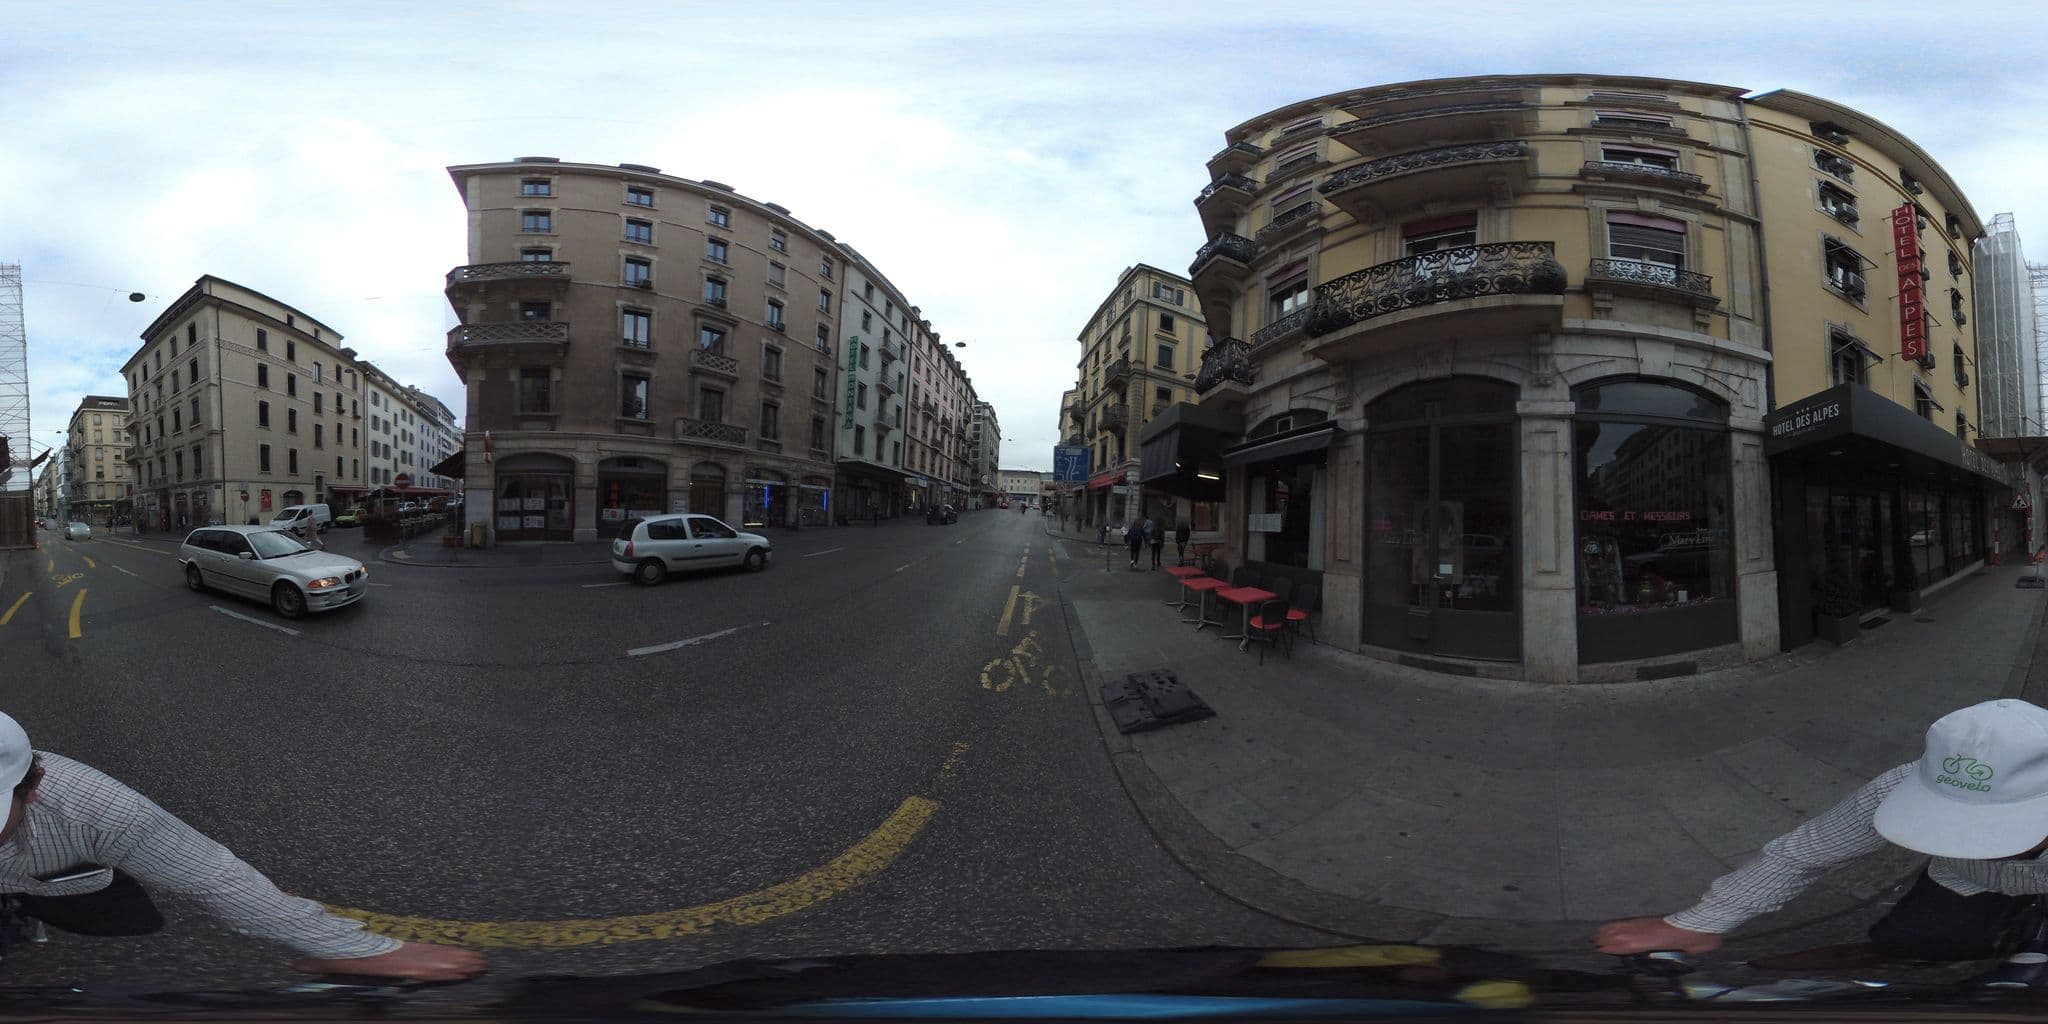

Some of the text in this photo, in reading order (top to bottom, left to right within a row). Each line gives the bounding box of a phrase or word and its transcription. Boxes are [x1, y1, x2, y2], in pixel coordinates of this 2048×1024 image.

[1895, 209, 1911, 257] HOTEL
[1902, 277, 1918, 355] ALPES
[1773, 420, 1794, 436] HOTEL
[1796, 413, 1810, 428] DES
[1812, 404, 1839, 423] ALPES
[1580, 511, 1691, 521] DAMES ET MESSIEURS
[1936, 775, 1991, 792] geovelo
